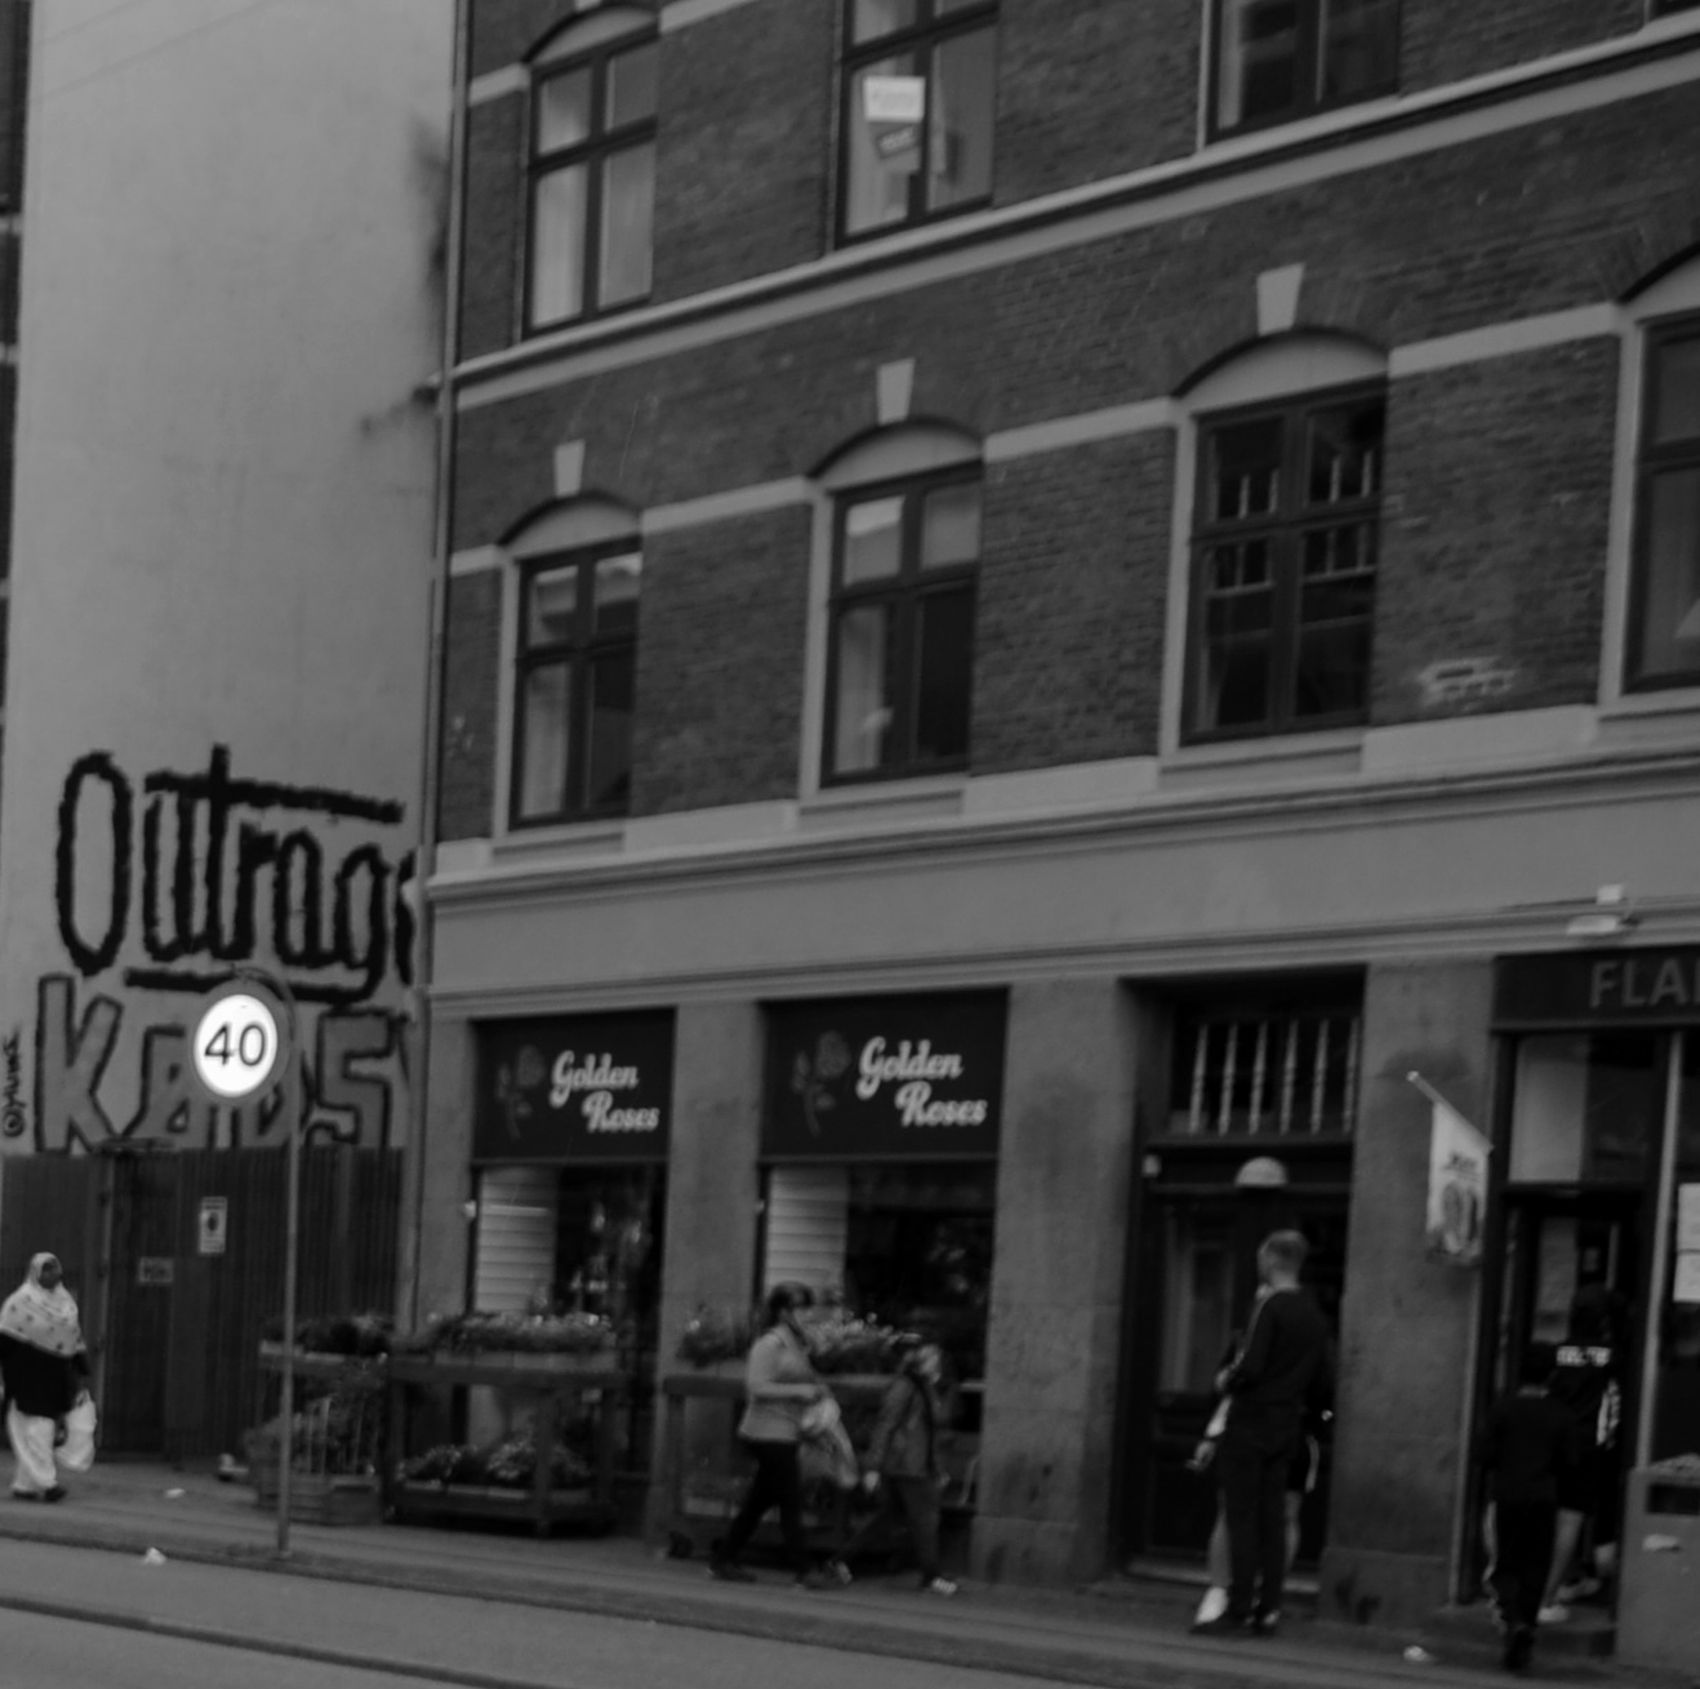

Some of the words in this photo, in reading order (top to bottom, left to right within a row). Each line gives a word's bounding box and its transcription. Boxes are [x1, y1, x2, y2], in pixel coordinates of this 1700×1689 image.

[1588, 956, 1700, 1010] FLA
[203, 1021, 269, 1067] 40
[855, 1036, 964, 1101] Golden
[550, 1050, 640, 1109] Golden
[894, 1081, 988, 1128] Roses
[581, 1090, 661, 1134] Roses
